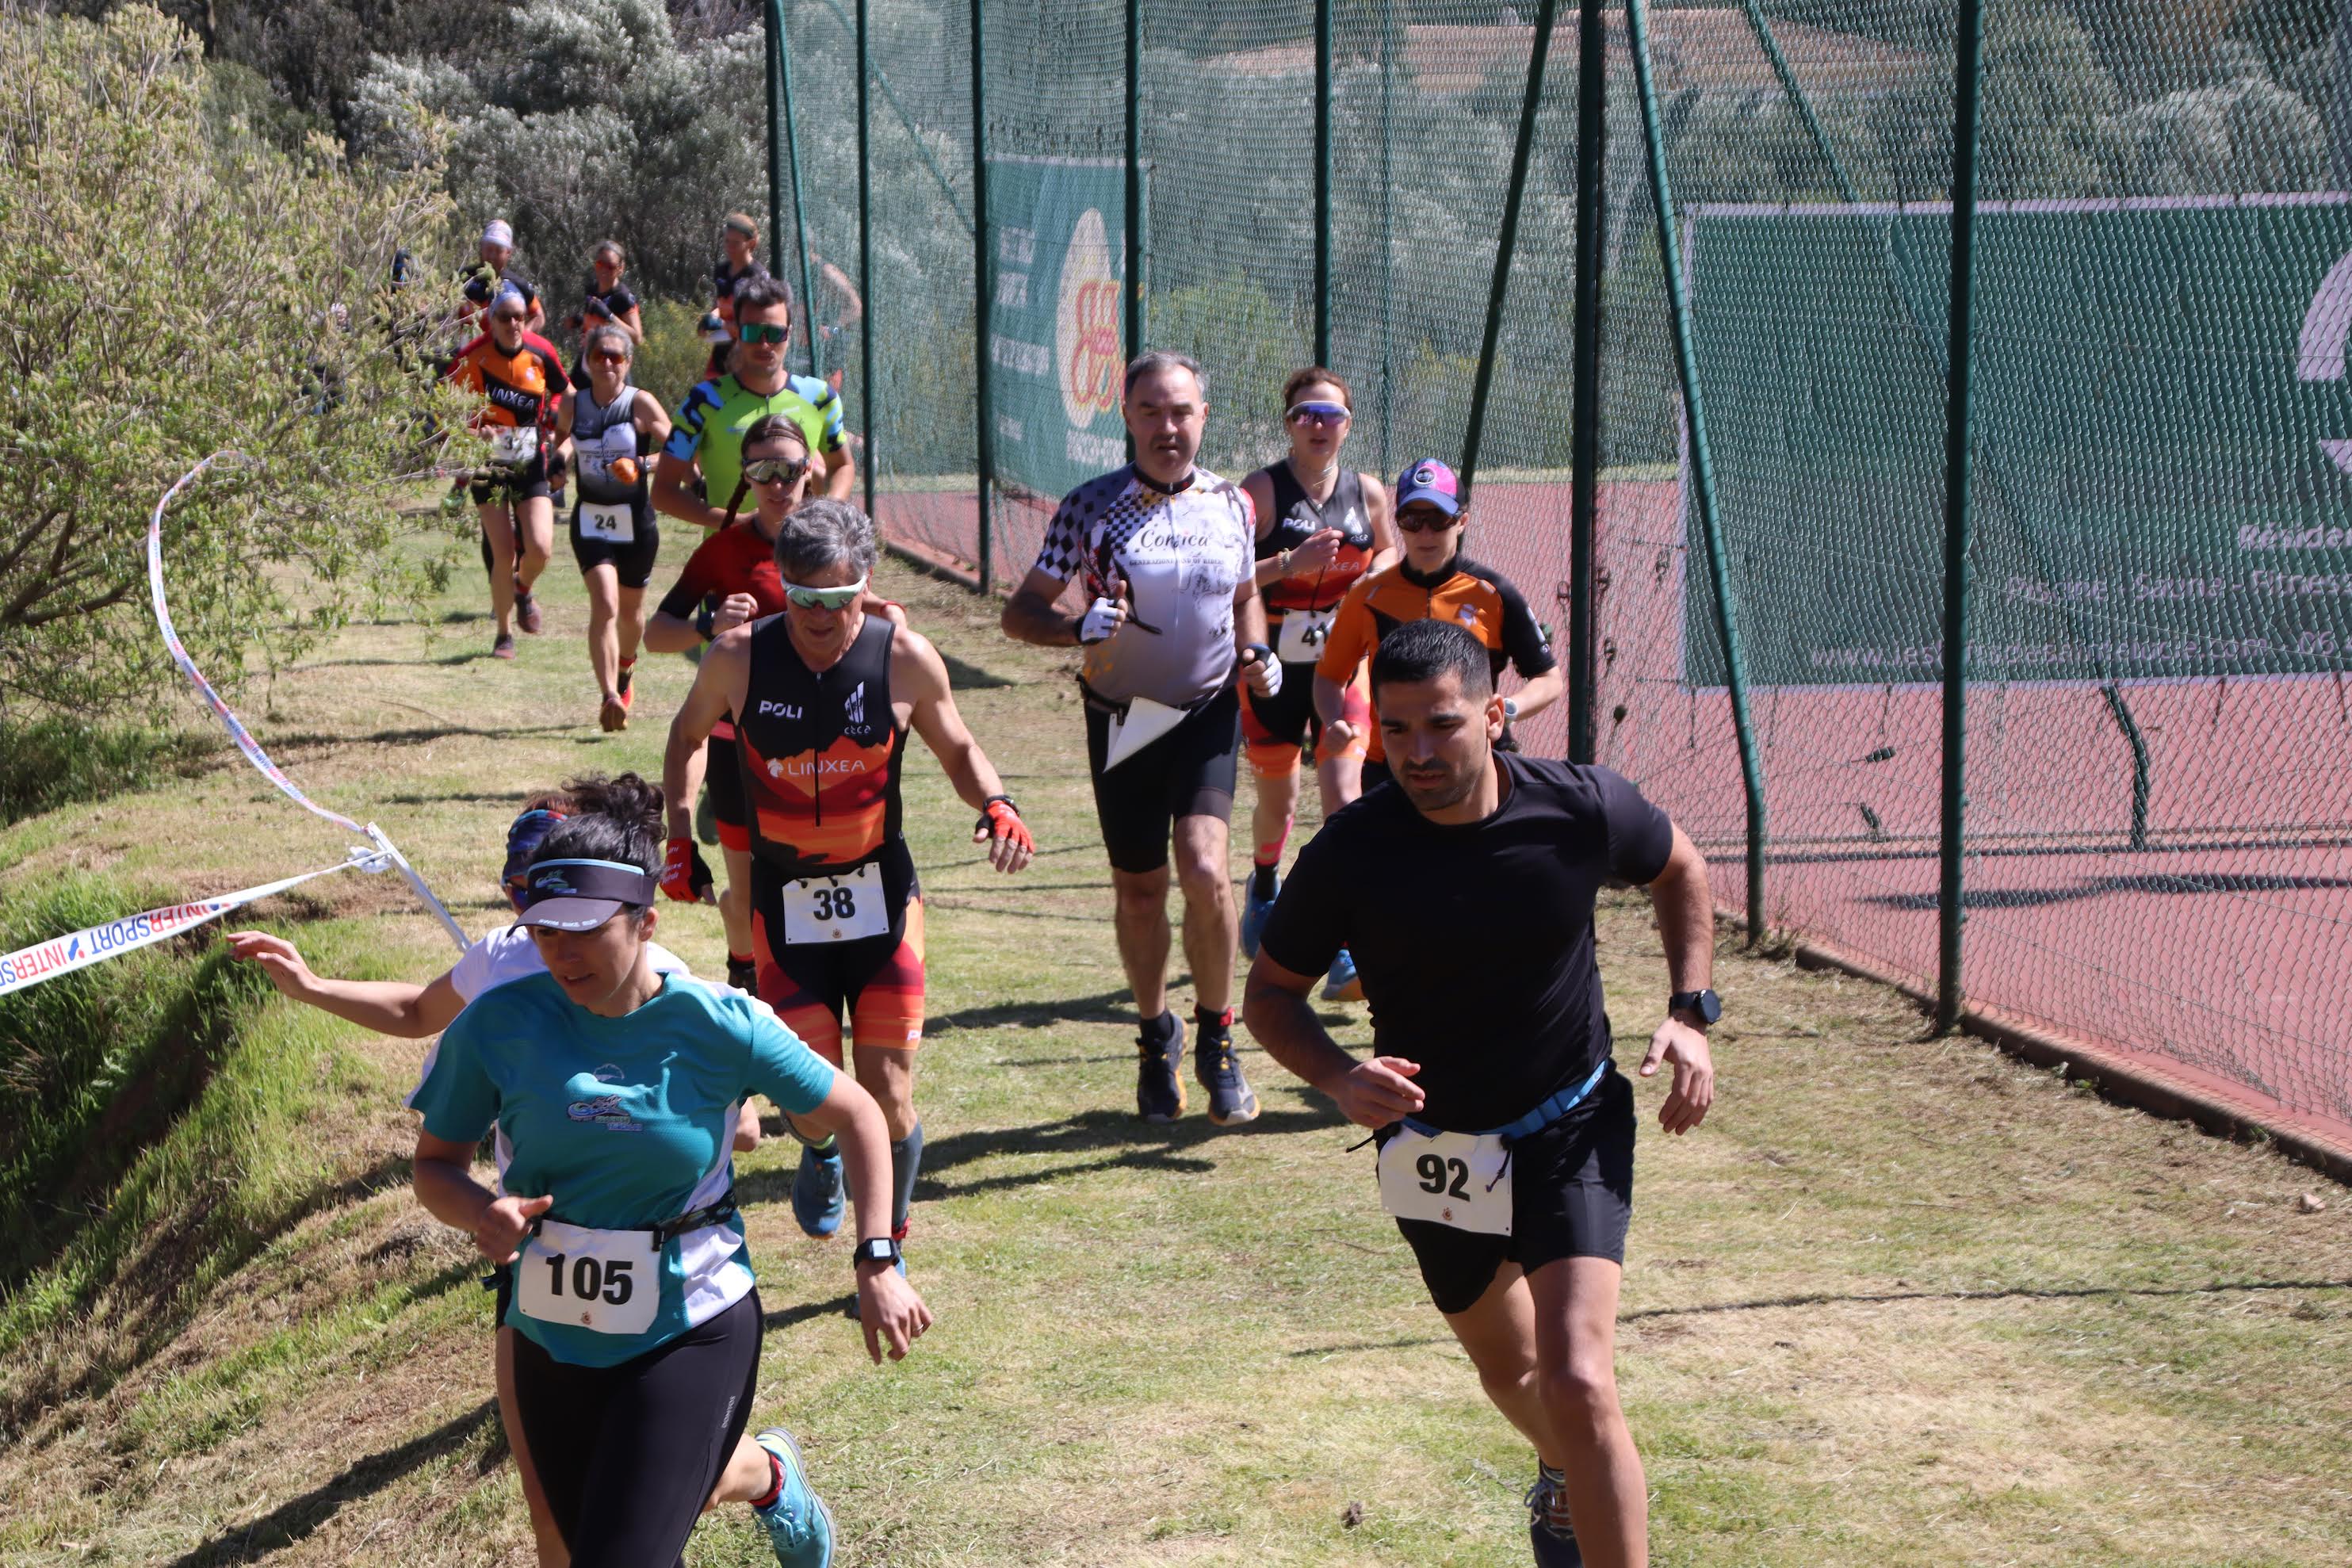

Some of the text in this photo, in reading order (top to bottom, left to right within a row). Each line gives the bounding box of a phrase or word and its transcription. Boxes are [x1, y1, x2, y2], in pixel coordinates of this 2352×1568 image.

[595, 514, 617, 530] 24
[1283, 518, 1316, 532] POLI
[2135, 572, 2223, 599] Sauna
[759, 699, 803, 719] POLI
[788, 759, 866, 776] LINXEA
[813, 887, 855, 921] 38
[91, 903, 210, 954] INTERSPORT
[1416, 1153, 1470, 1203] 92
[545, 1252, 634, 1306] 105
